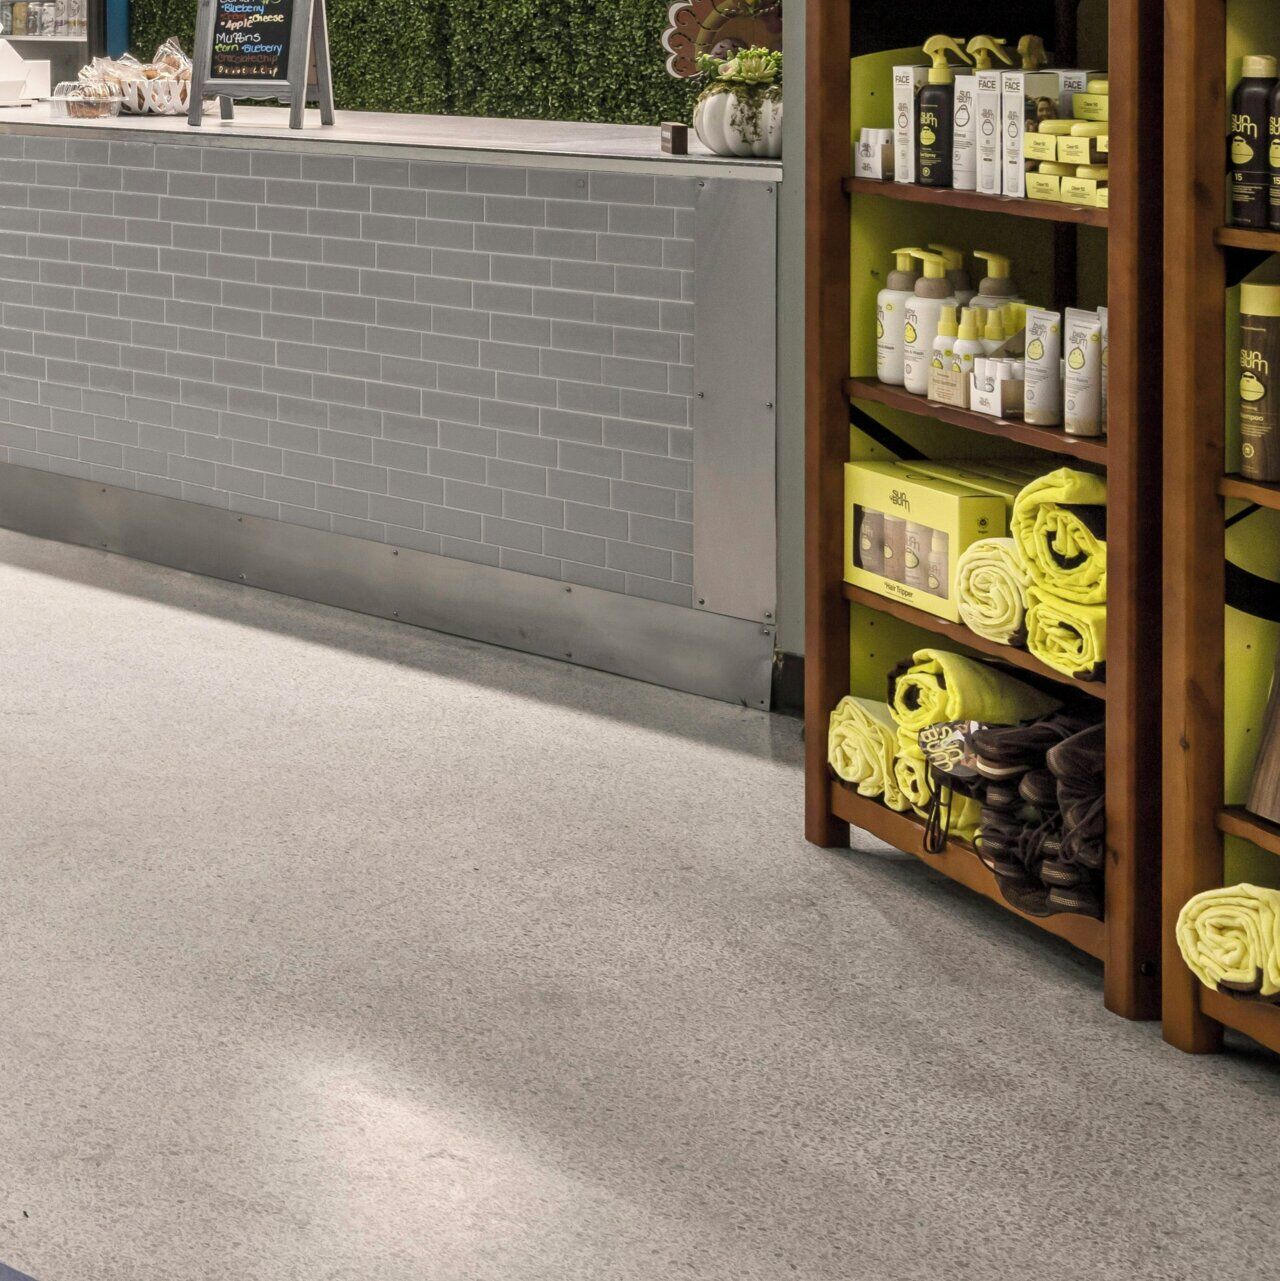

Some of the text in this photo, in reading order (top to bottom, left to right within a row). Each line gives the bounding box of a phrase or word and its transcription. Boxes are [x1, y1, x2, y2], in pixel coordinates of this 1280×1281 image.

[252, 14, 285, 22] Cheese
[225, 17, 254, 30] Apple
[215, 32, 261, 44] Muffins
[895, 74, 910, 84] FACE
[978, 78, 997, 89] FACE
[1004, 81, 1021, 92] FACE
[1062, 80, 1082, 90] FACE
[1234, 172, 1243, 181] 15
